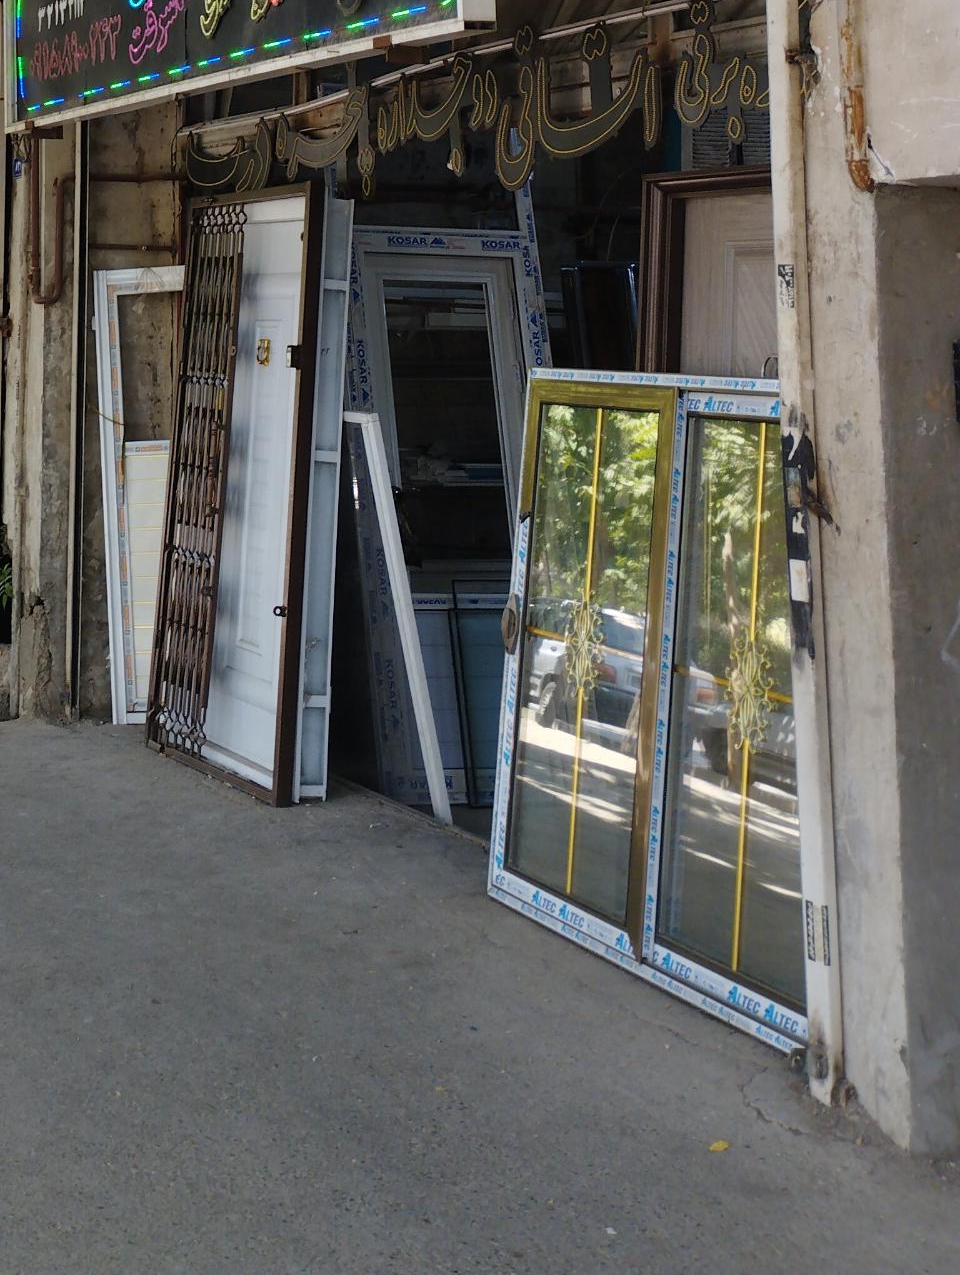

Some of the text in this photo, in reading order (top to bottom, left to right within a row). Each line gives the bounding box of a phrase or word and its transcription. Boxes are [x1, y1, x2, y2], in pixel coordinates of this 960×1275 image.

[388, 235, 427, 248] KOSAR
[481, 239, 521, 251] KOSAR
[522, 245, 533, 278] KOSA
[357, 339, 368, 385] KOSAR
[532, 331, 543, 367] OSAR
[702, 396, 734, 412] ALTEC
[503, 667, 516, 767] ALTEC ALTEC
[495, 820, 505, 870] ALTEC
[531, 890, 557, 914] ALTEC
[558, 903, 585, 928] ALTEC
[662, 951, 692, 980] ALTEC
[727, 984, 761, 1015] ALTEC
[764, 1002, 799, 1034] ALTEC
